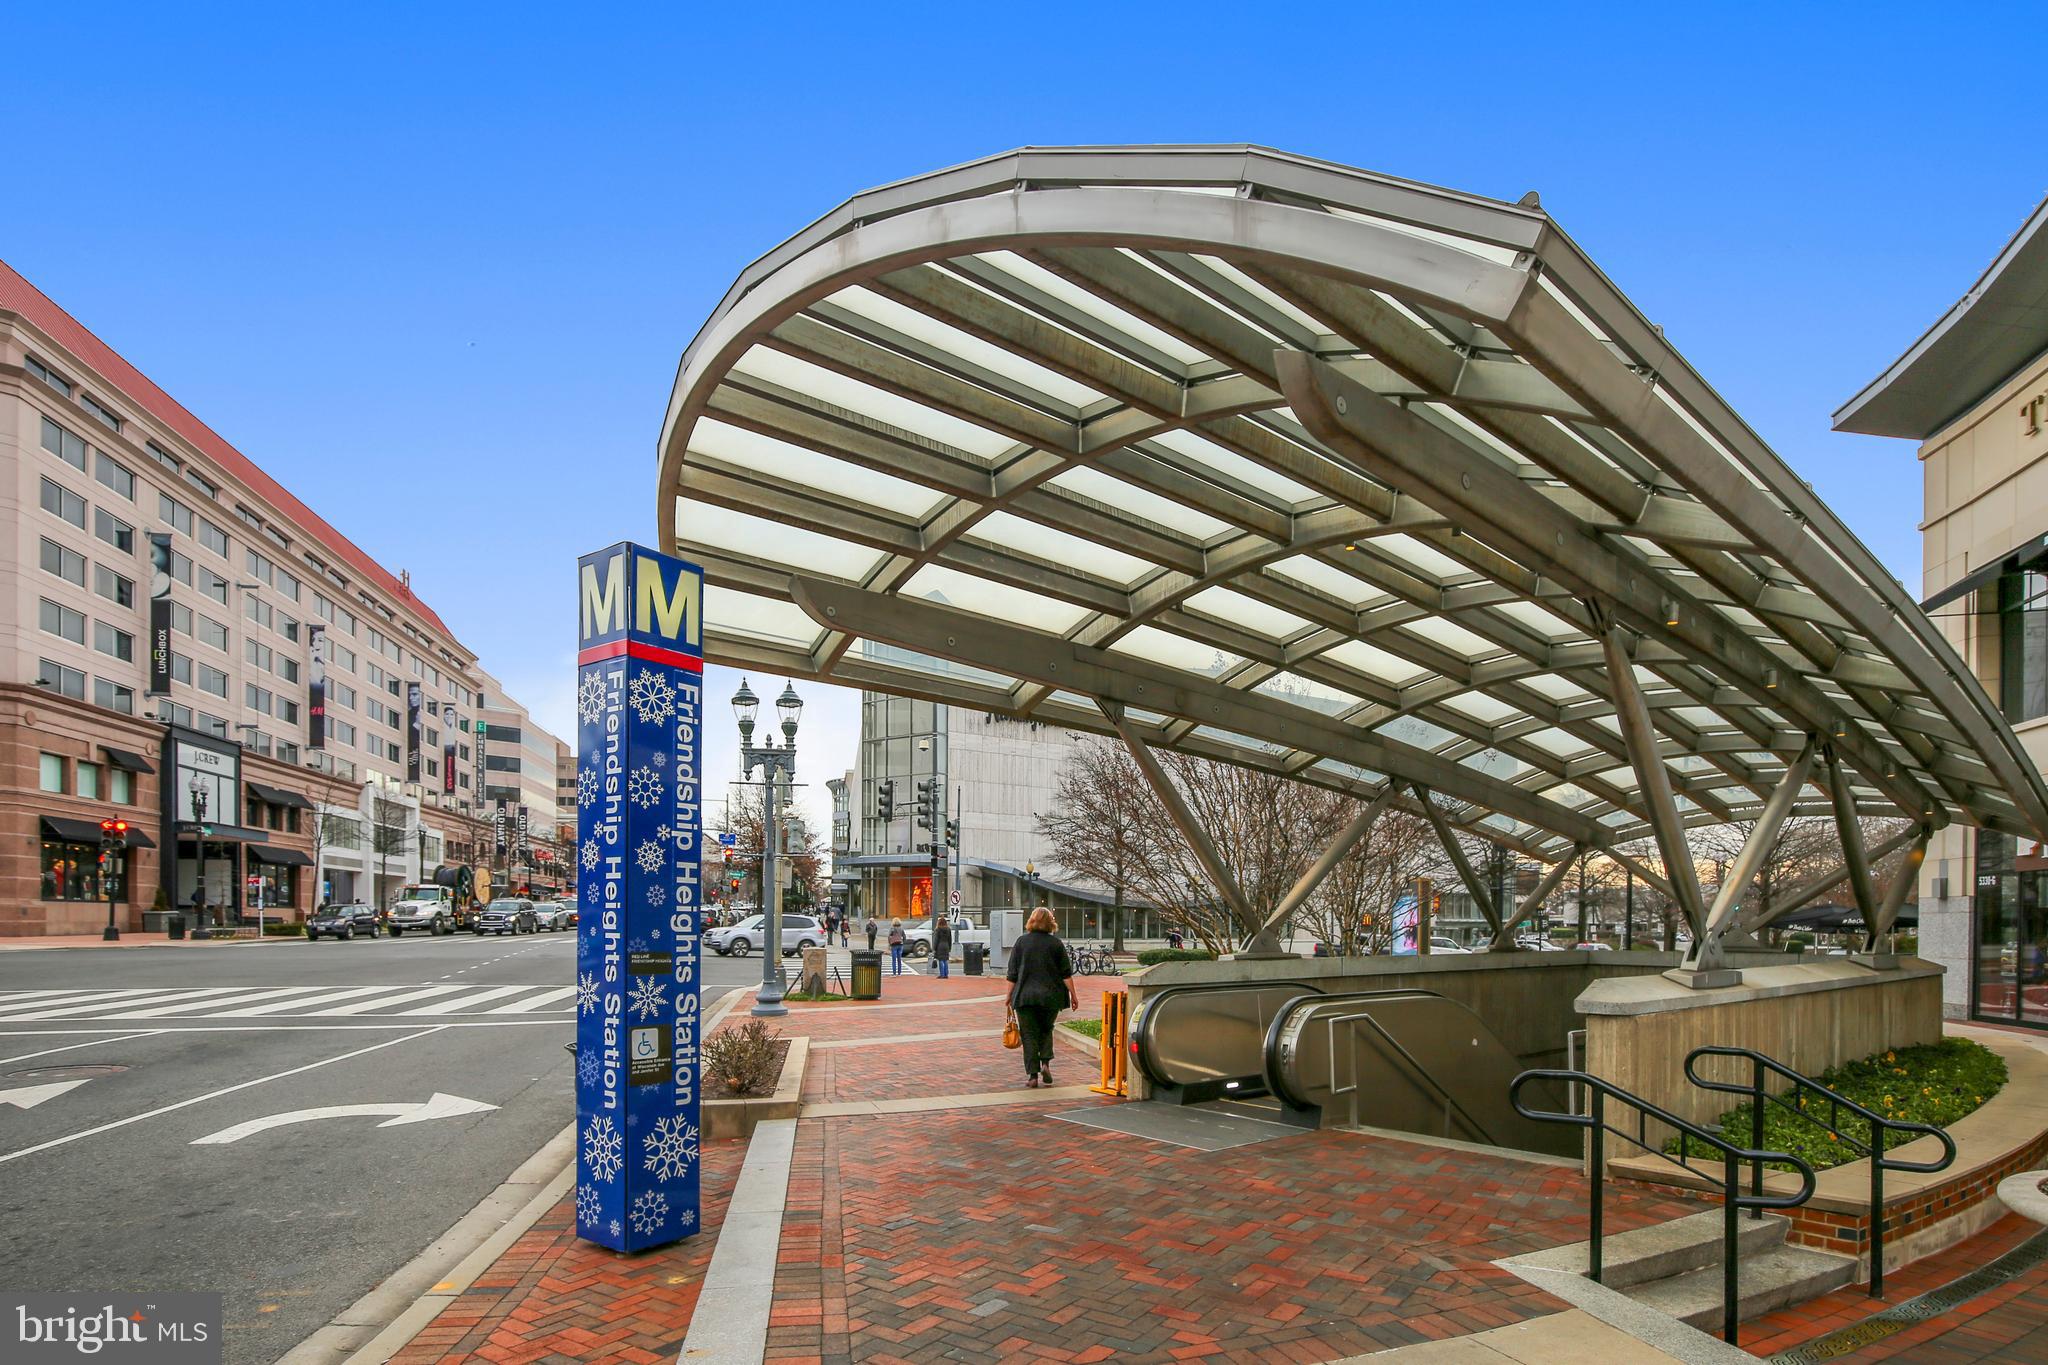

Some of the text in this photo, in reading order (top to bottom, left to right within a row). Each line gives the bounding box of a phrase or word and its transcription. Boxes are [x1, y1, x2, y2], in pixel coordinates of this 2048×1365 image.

[581, 553, 624, 640] M
[636, 555, 700, 646] M
[158, 629, 167, 673] LUNCHBOX
[602, 669, 624, 1109] Friendship Heights Station
[670, 682, 699, 1105] Friendship Heights Station
